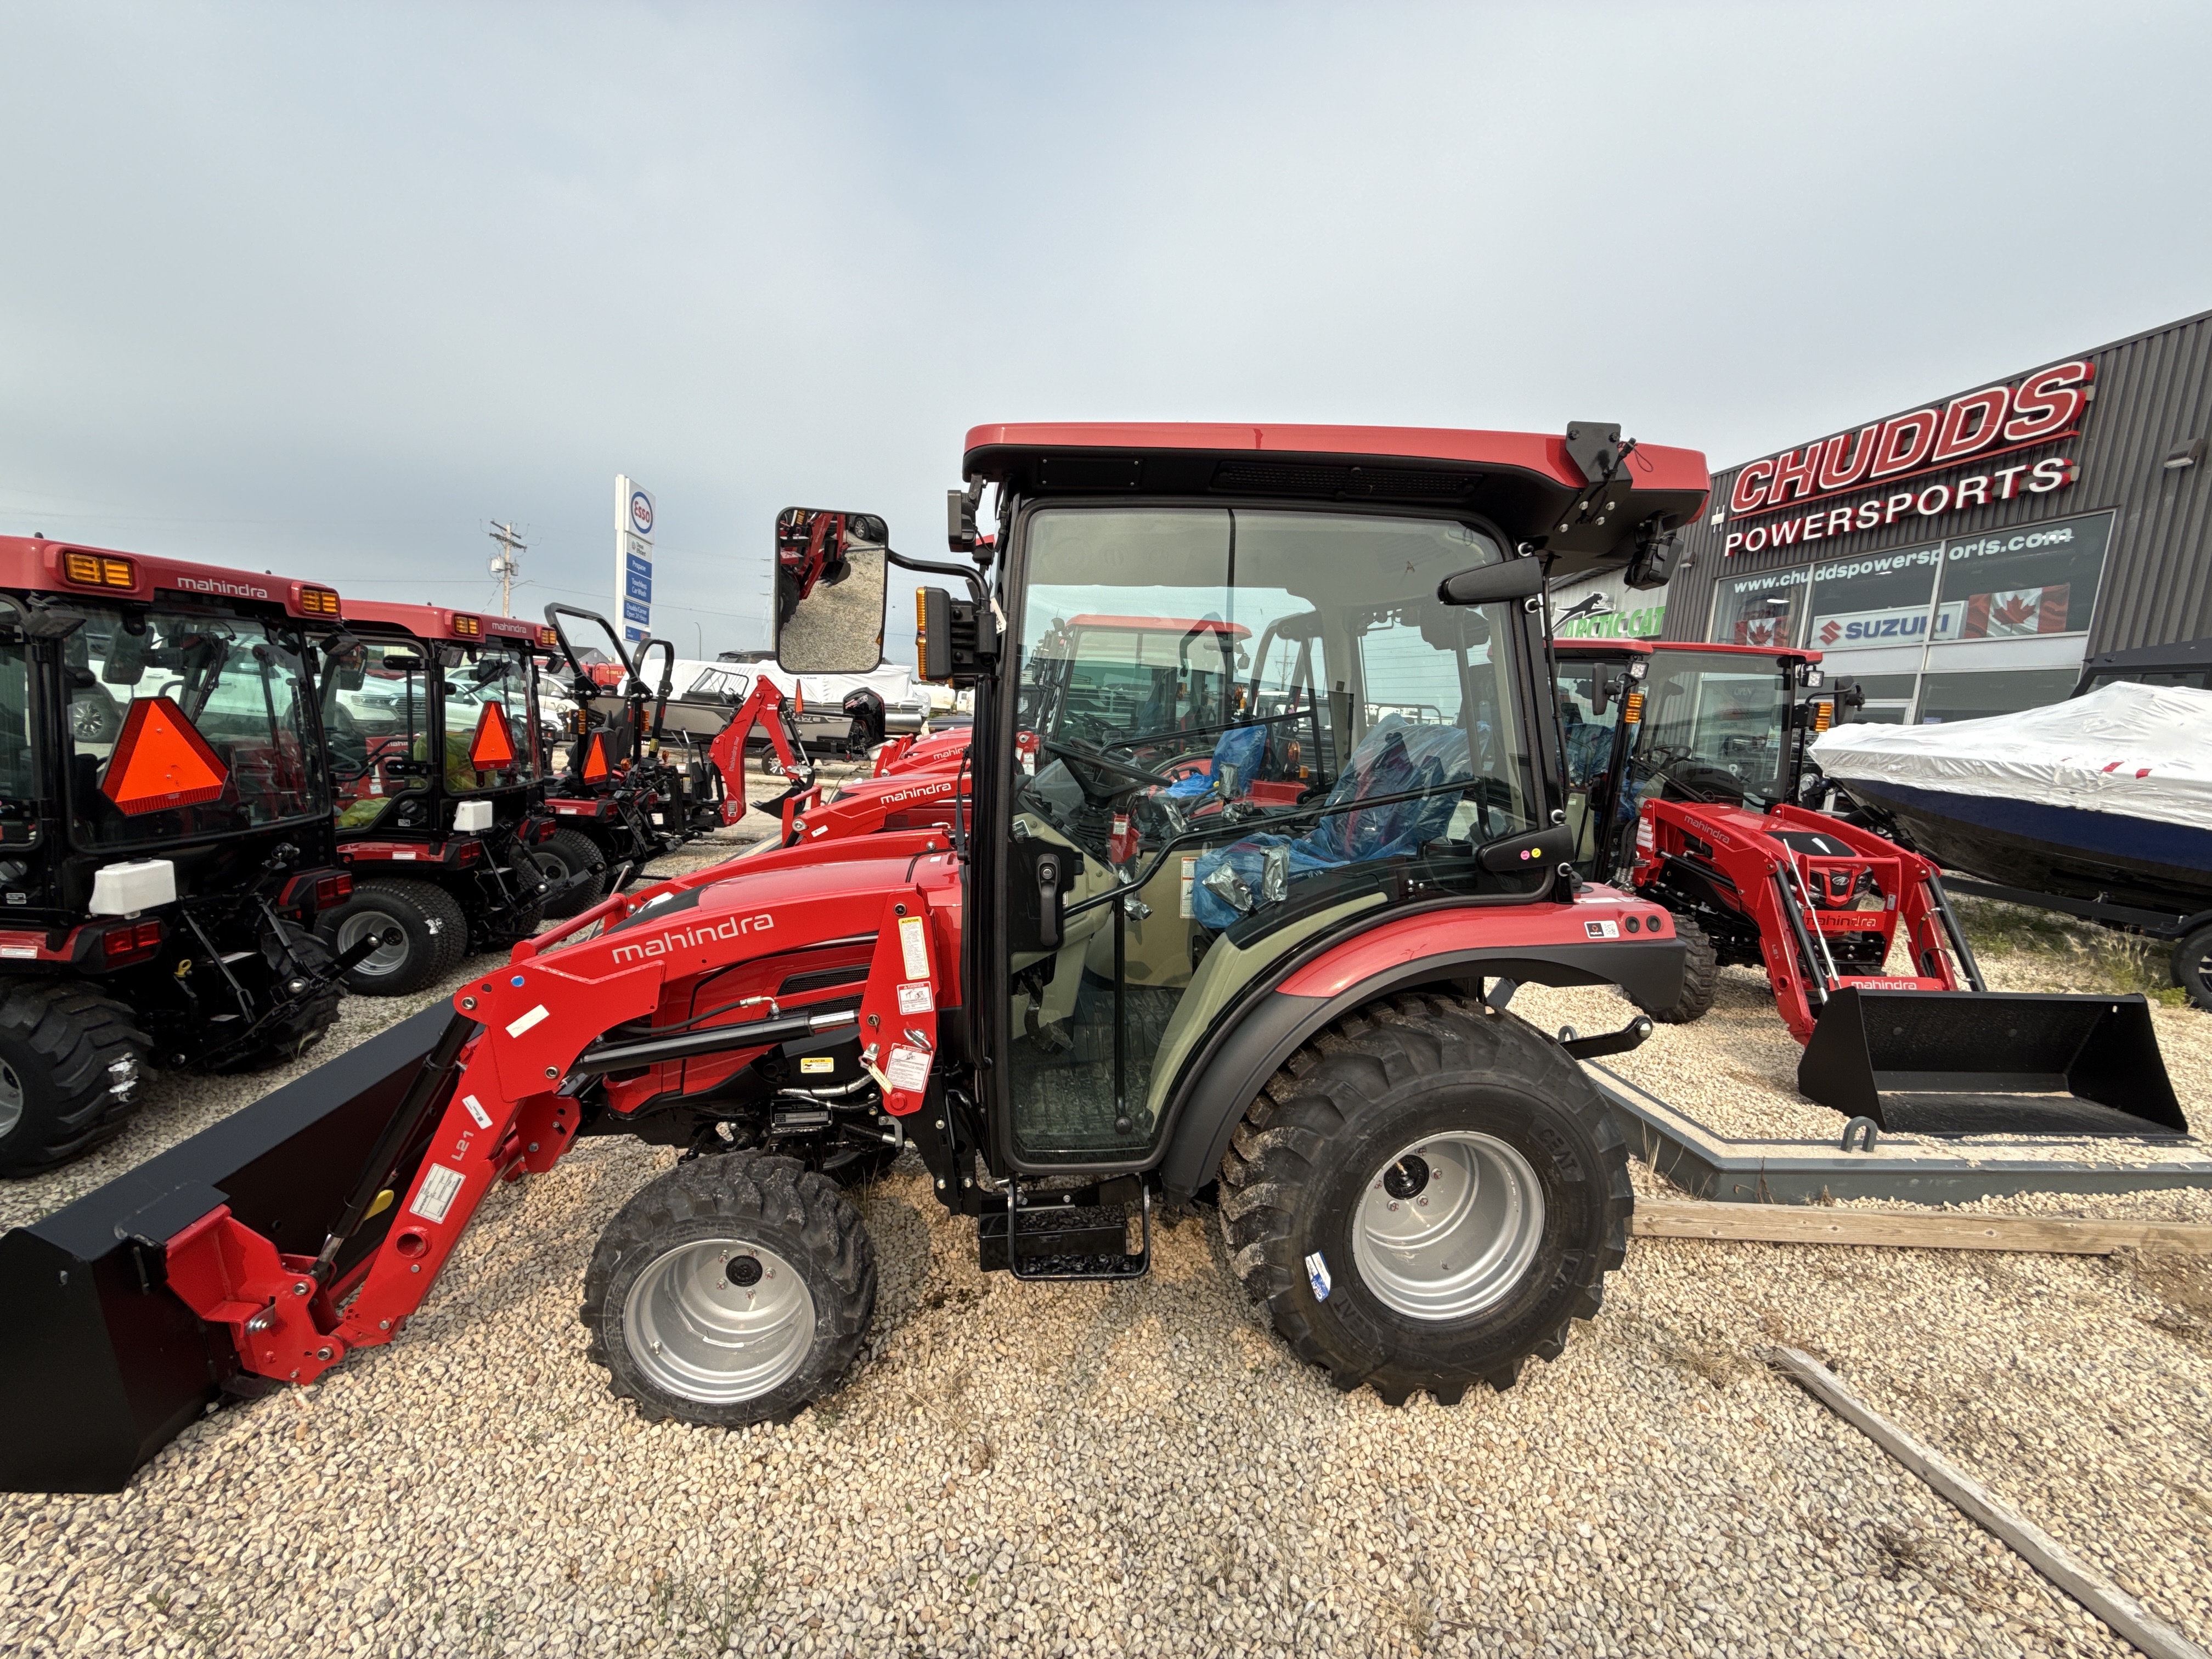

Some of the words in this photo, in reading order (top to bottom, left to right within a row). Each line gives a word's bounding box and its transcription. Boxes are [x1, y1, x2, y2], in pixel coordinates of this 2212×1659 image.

[1730, 361, 2094, 512] CHUDDS
[1724, 458, 2072, 556] POWERSPORTS
[632, 560, 646, 572] Propane
[1734, 527, 2072, 594] www.chuddspowersports.com
[177, 577, 268, 599] mahindra
[631, 577, 647, 590] Touchless
[492, 622, 527, 633] mahindra
[1564, 611, 1626, 638] ARCTIC
[1627, 606, 1666, 638] CAT
[933, 747, 964, 760] mahin
[880, 782, 952, 805] mahindra
[1684, 815, 1730, 844] mahindra
[1805, 916, 1877, 927] mahindra
[612, 913, 774, 964] mahindra
[1851, 979, 1917, 990] mahindra
[451, 1130, 475, 1161] L21
[1538, 1128, 1578, 1170] CEAT
